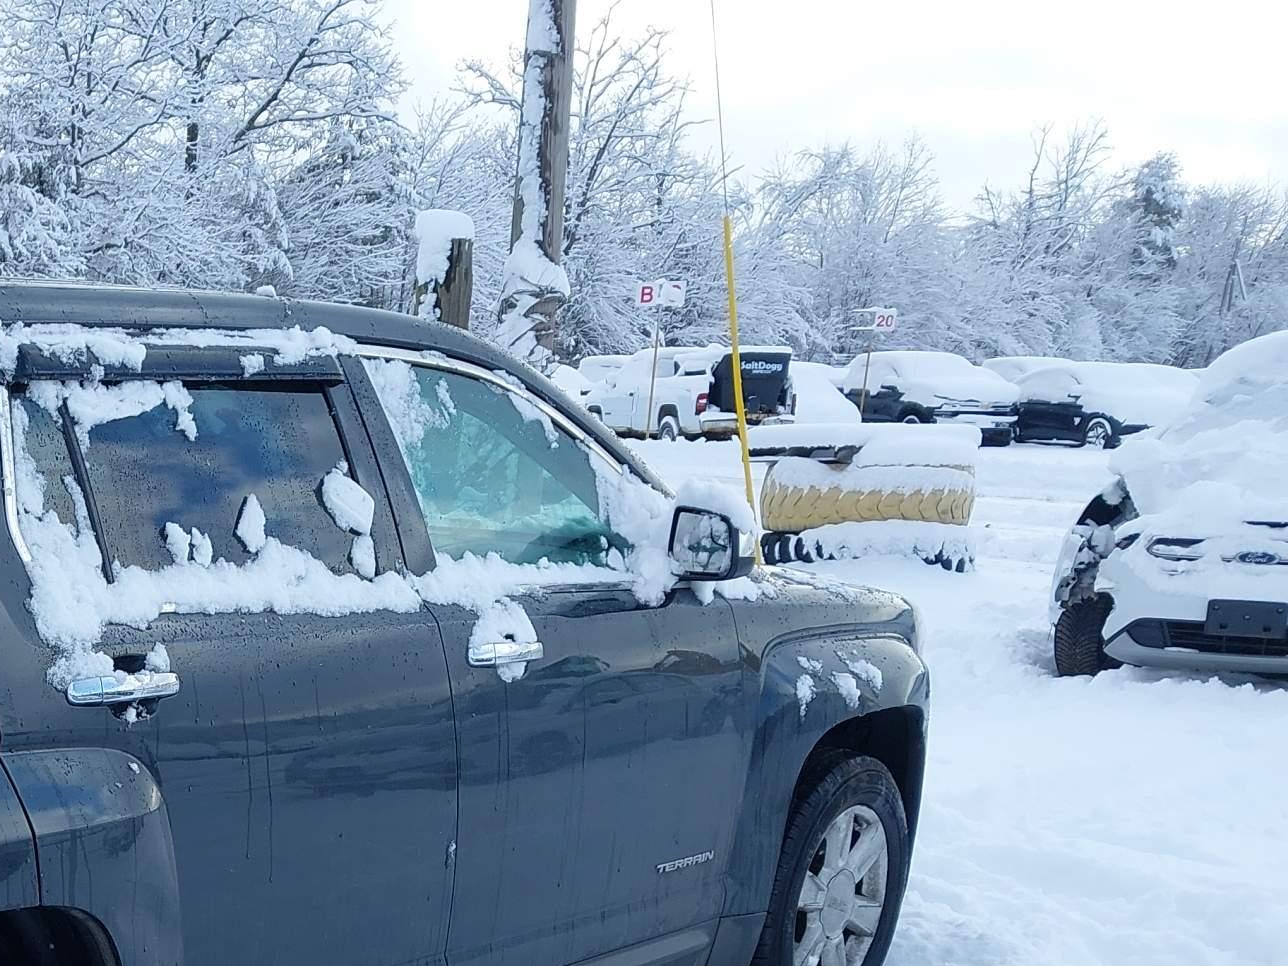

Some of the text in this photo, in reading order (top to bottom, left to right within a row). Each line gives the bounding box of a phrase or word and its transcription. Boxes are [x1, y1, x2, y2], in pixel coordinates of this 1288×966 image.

[640, 285, 654, 304] B
[876, 314, 894, 328] 20
[740, 360, 783, 371] SaltDogg
[656, 850, 715, 874] TERRAIN
